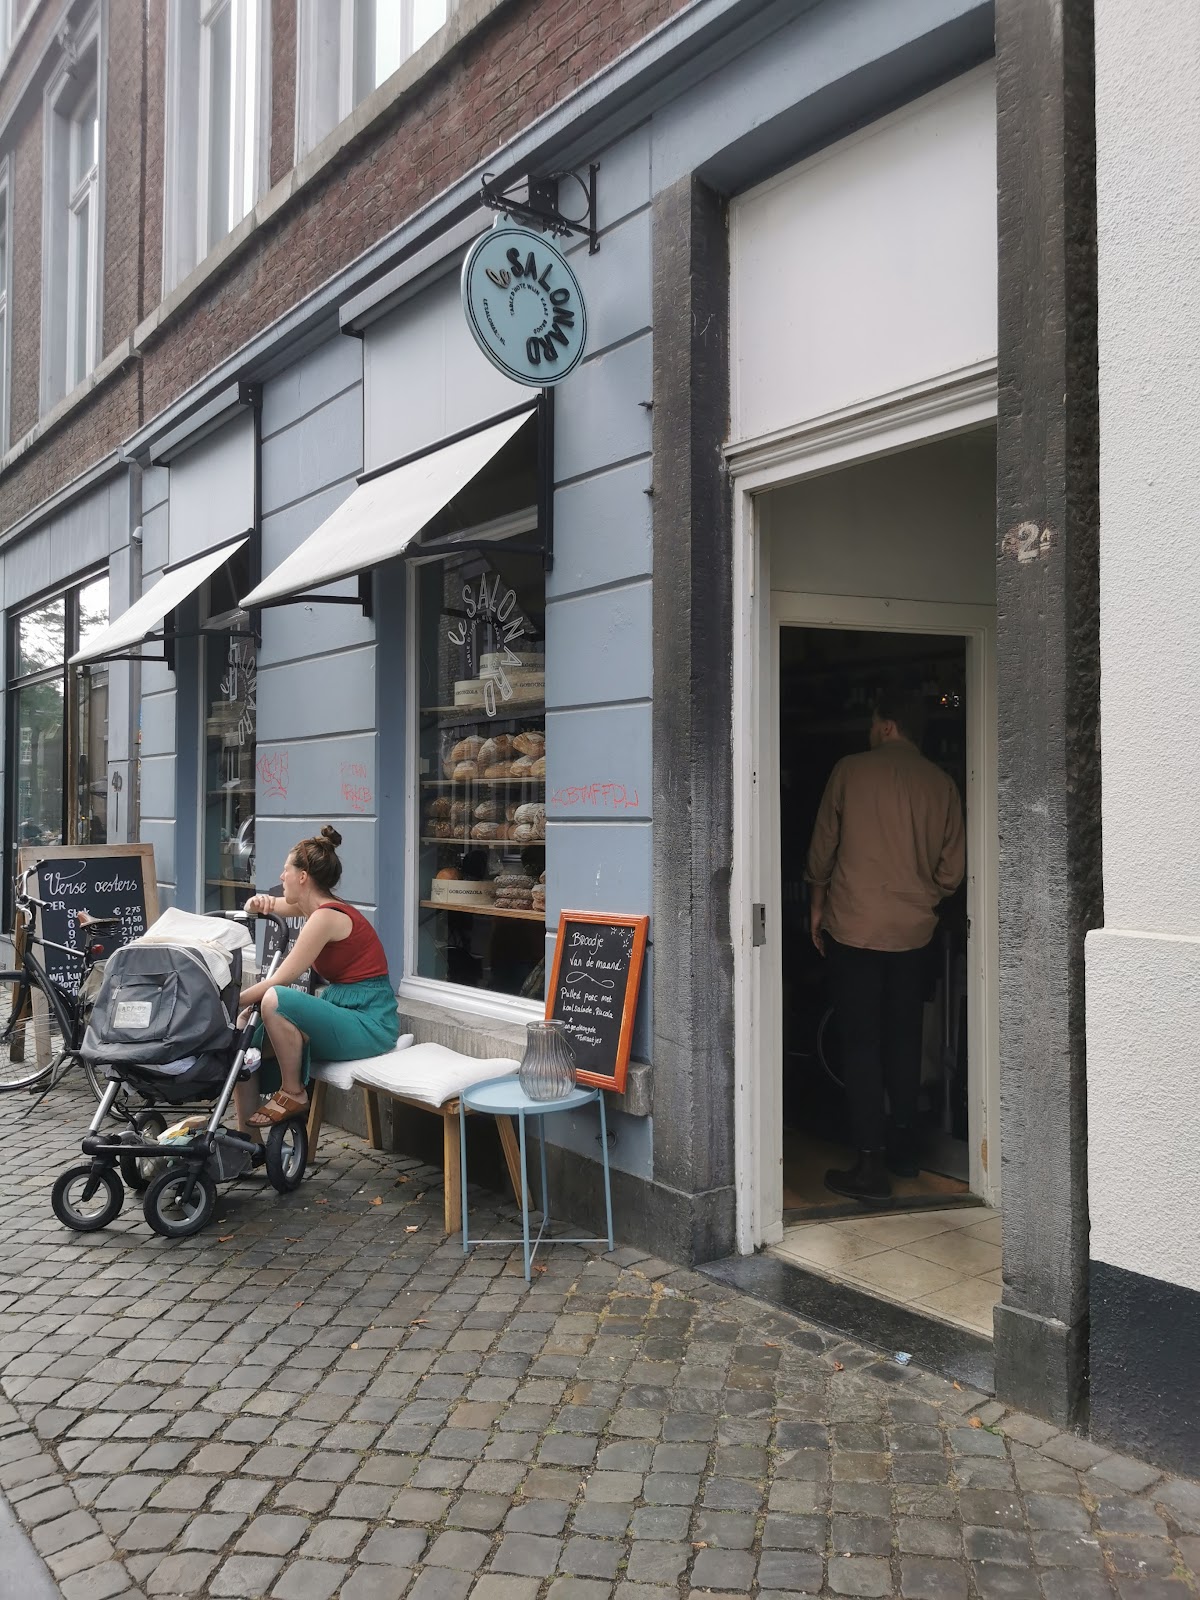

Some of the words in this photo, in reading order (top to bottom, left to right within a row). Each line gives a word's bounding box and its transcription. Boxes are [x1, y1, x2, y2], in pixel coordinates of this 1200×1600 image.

[485, 267, 512, 289] le
[506, 247, 575, 365] SALONARD
[447, 618, 467, 646] le
[461, 572, 525, 718] SALONARD
[44, 861, 87, 895] Verse
[94, 873, 138, 893] oesters
[448, 888, 483, 896] GORGONZOLA
[67, 919, 75, 929] 6
[68, 930, 76, 940] 9
[568, 931, 604, 955] Broodje
[585, 956, 595, 967] de
[560, 986, 582, 1000] Pulled
[600, 995, 613, 1003] met
[574, 1033, 603, 1047] Tomaatjes
